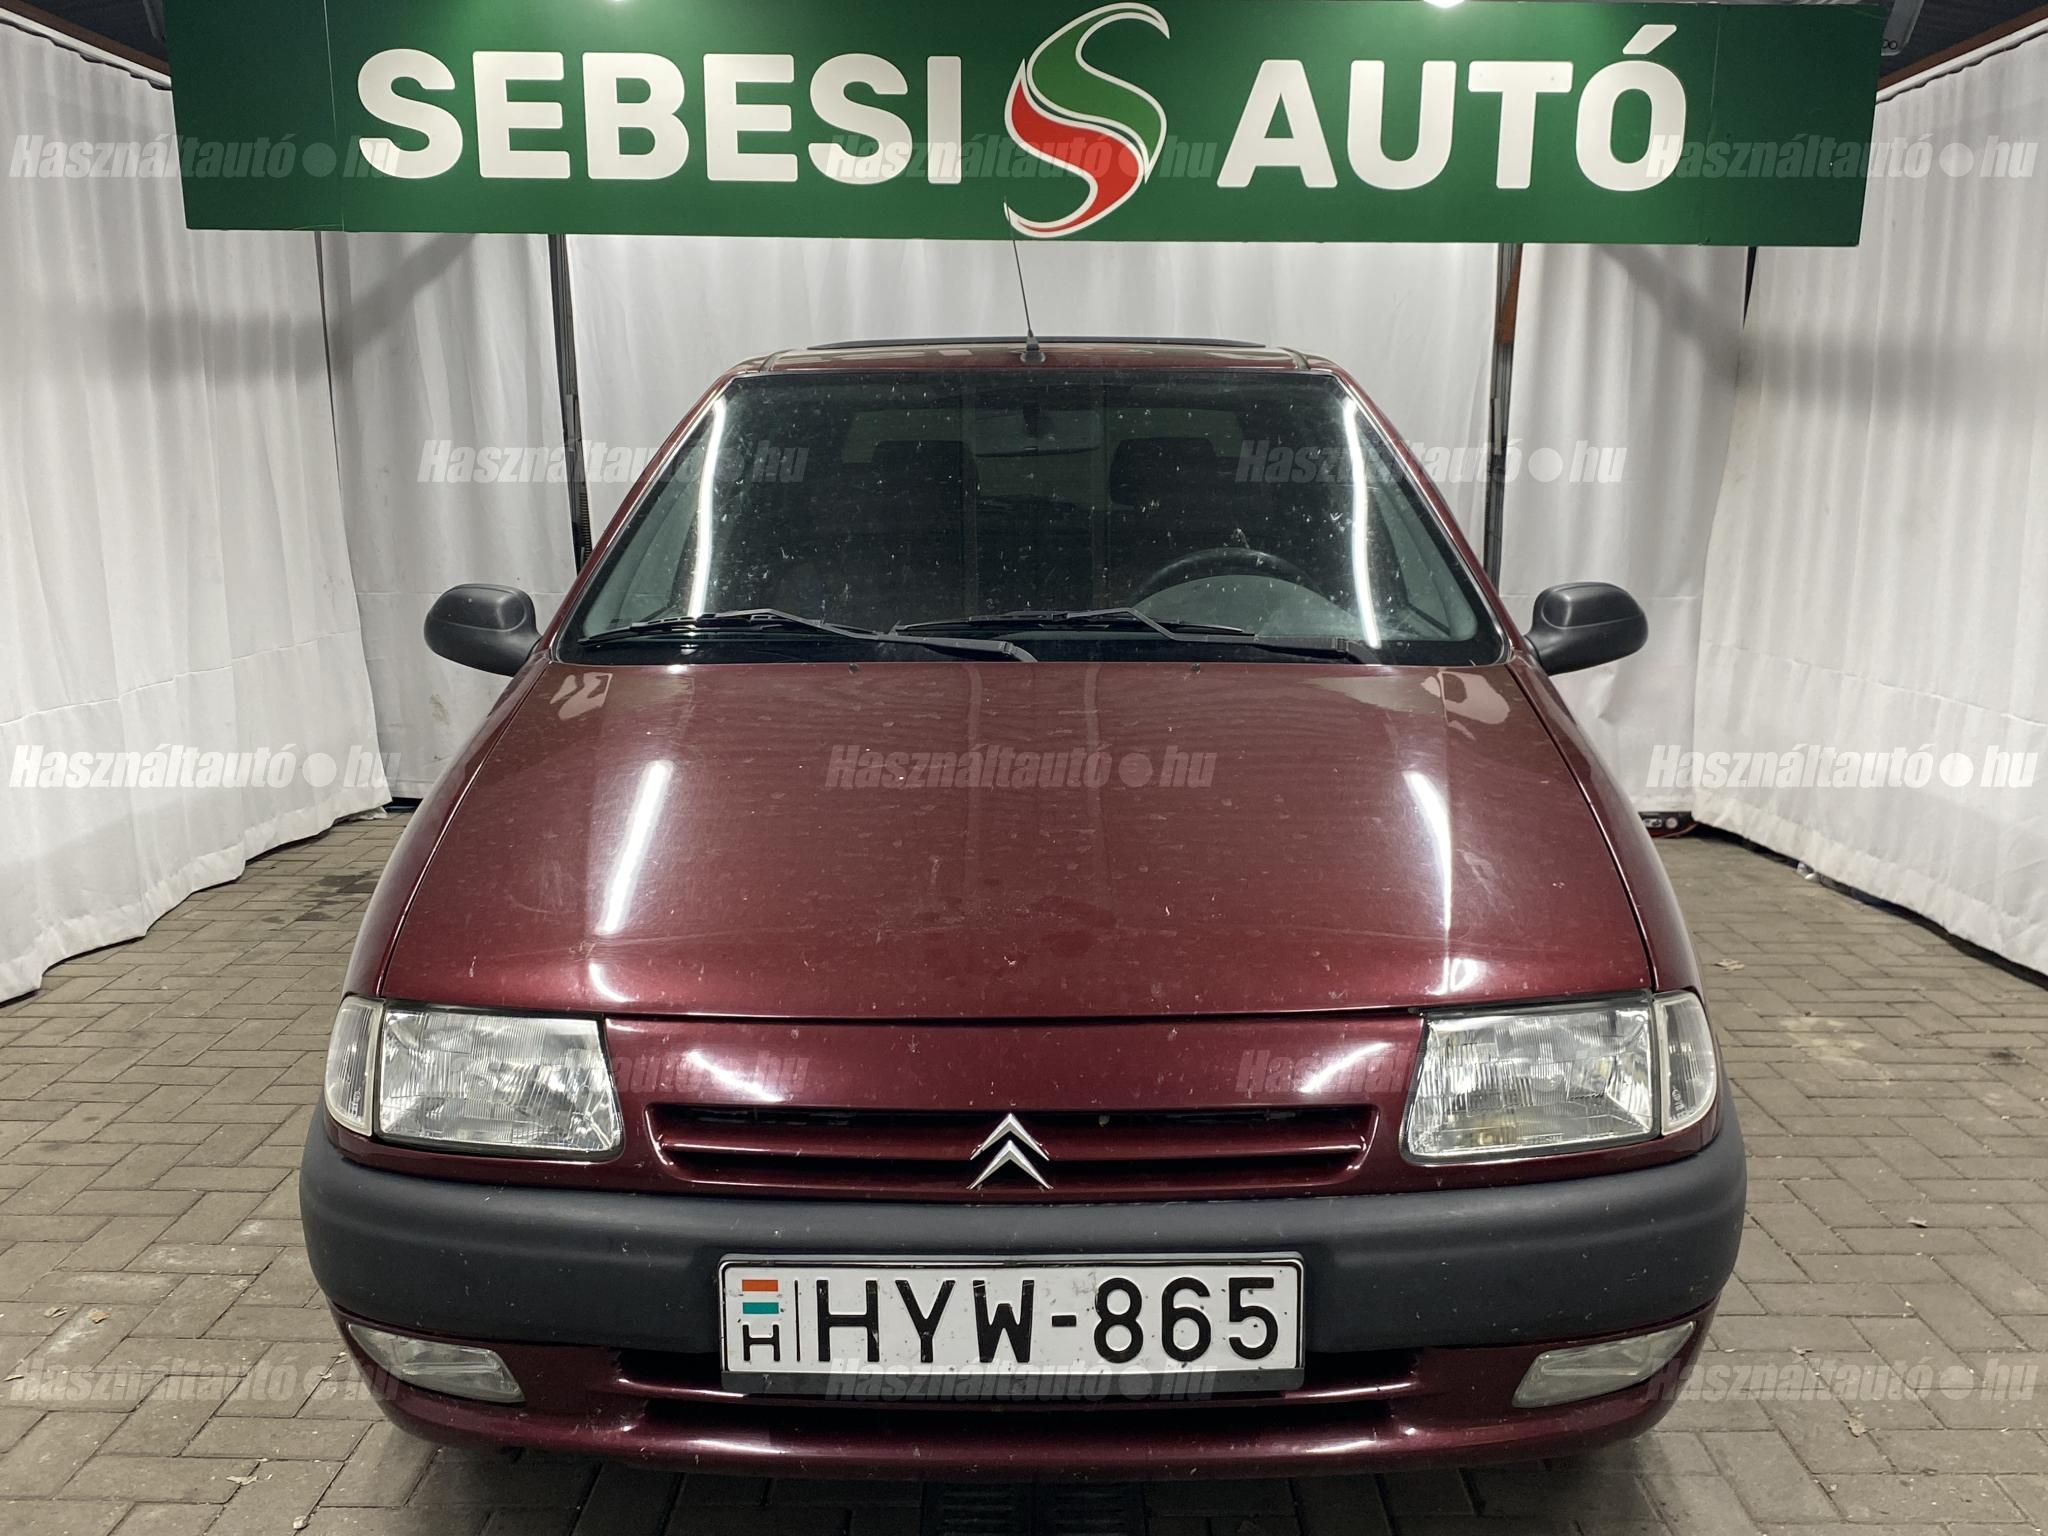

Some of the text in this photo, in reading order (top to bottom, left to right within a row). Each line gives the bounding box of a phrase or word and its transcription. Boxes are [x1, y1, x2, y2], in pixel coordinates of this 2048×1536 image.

[357, 48, 962, 185] SEBESI
[1216, 24, 1688, 192] AUTÓ
[742, 1277, 1280, 1363] H HYW-865
